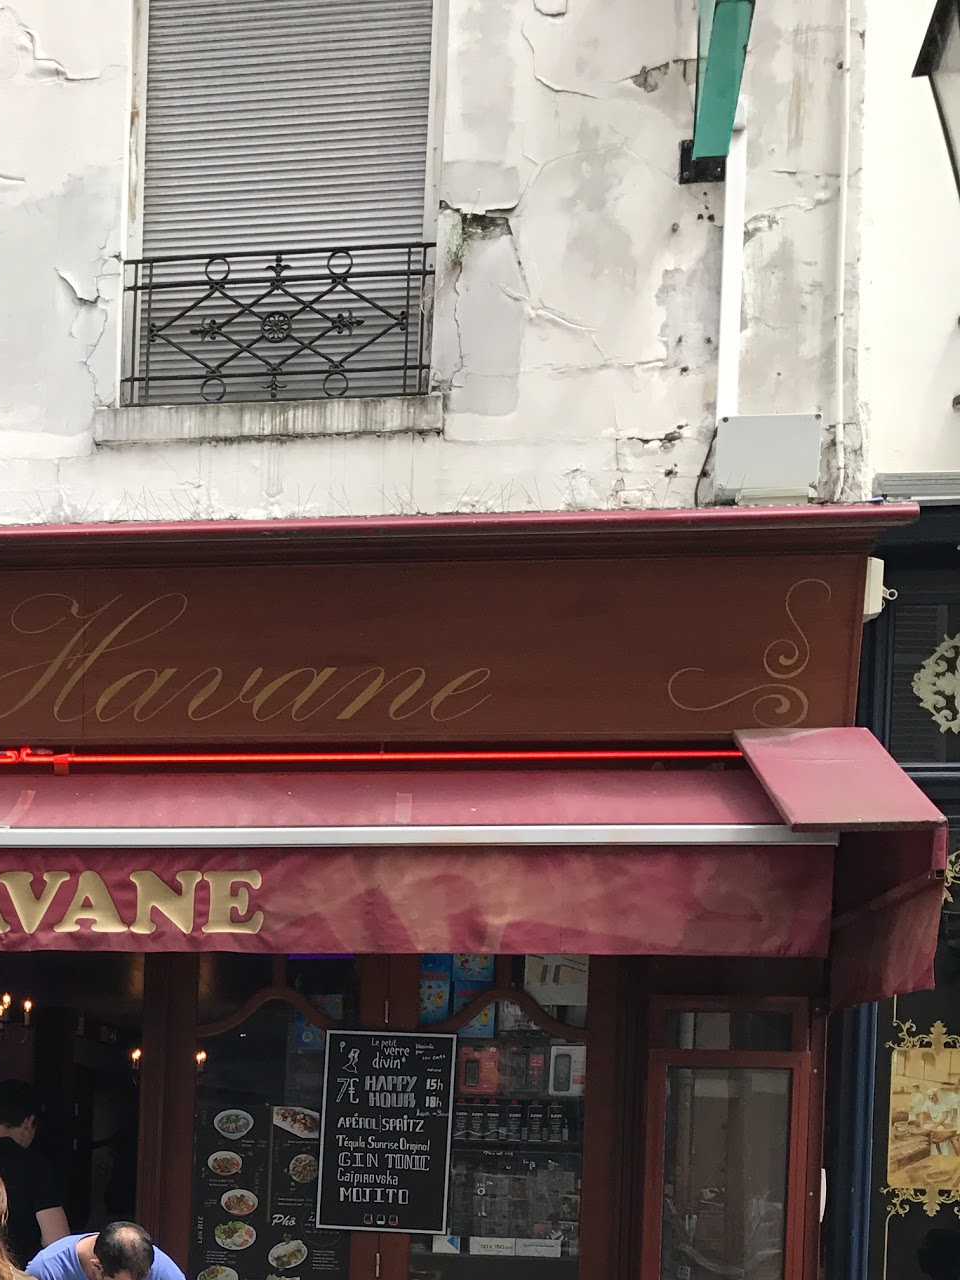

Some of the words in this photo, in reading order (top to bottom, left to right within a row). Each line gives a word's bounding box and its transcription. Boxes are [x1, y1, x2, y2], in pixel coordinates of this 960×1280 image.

[371, 1037, 380, 1047] Le
[380, 1039, 397, 1049] petit
[384, 1046, 410, 1056] verre
[336, 1077, 360, 1103] 7€
[364, 1075, 417, 1092] HAPPY
[425, 1078, 444, 1090] 15h
[368, 1092, 416, 1108] HOUR
[425, 1095, 442, 1108] 18h
[337, 1113, 379, 1129] APÉROL
[336, 1134, 365, 1151] Téquila
[367, 1136, 399, 1149] Sunrise
[399, 1137, 430, 1154] Original
[338, 1151, 379, 1168] GIN
[384, 1153, 430, 1171] TONIC
[339, 1187, 409, 1205] MOJITO
[271, 1213, 296, 1226] Phô
